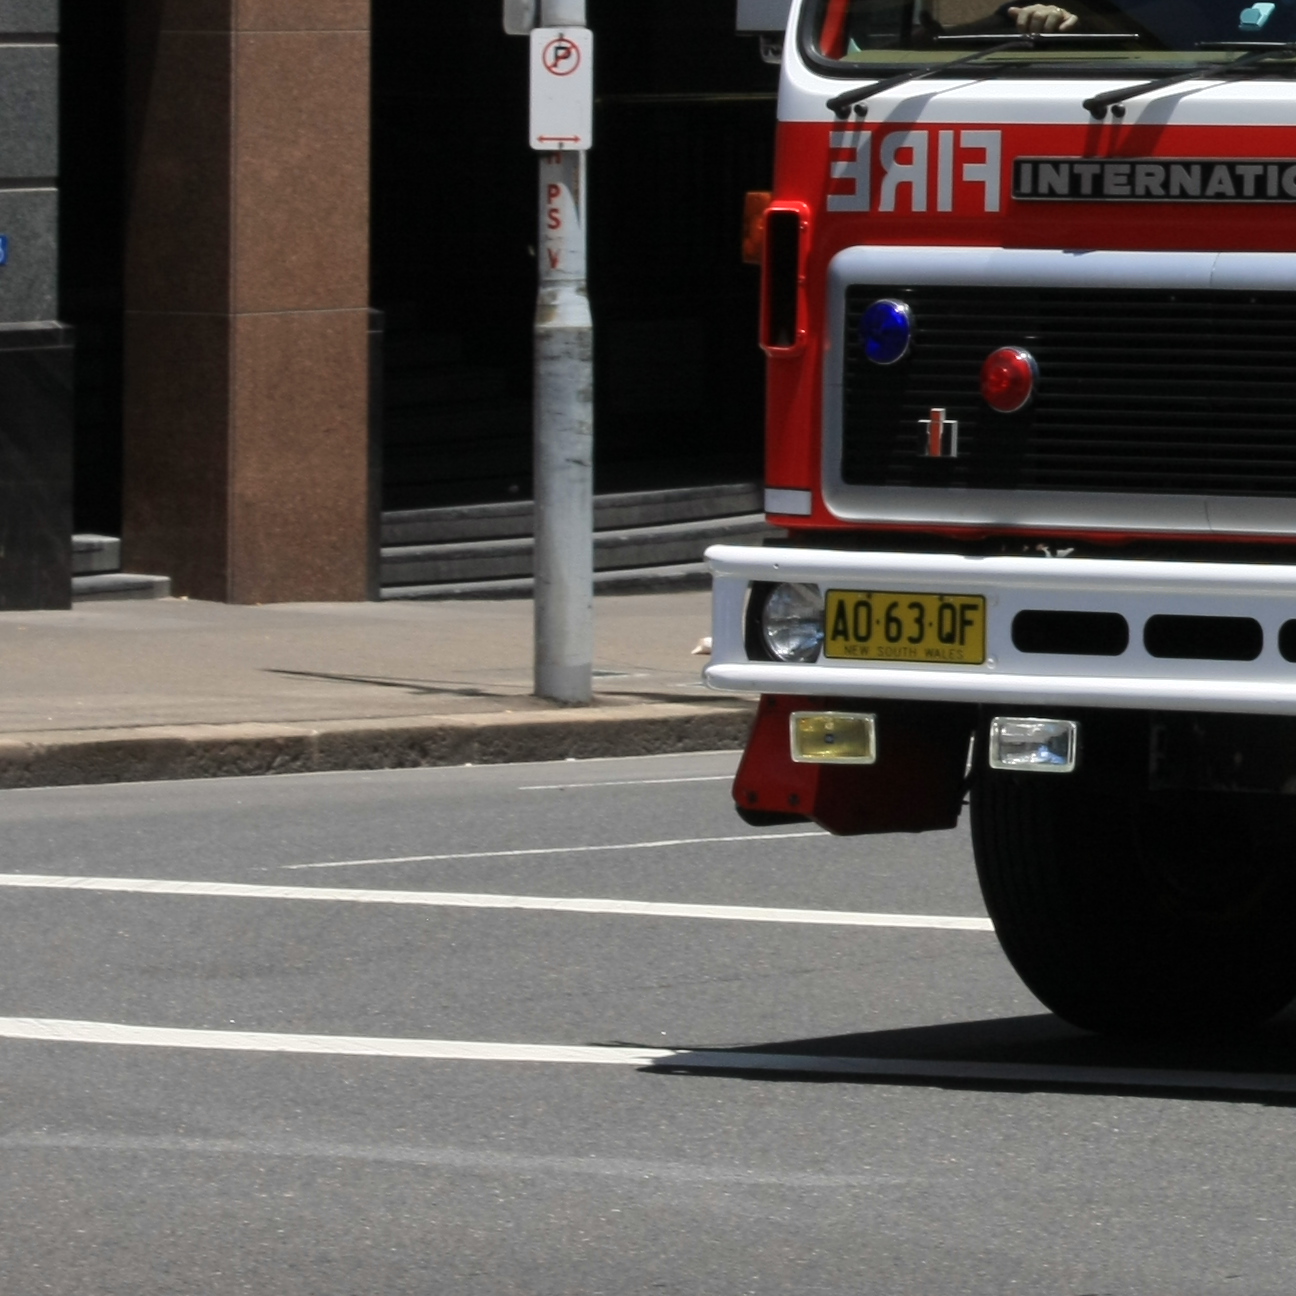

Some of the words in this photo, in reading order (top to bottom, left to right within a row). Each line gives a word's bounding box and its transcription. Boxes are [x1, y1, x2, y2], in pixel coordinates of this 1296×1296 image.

[844, 645, 869, 655] NEW
[877, 646, 917, 657] SOUTH
[924, 647, 964, 660] WALES
